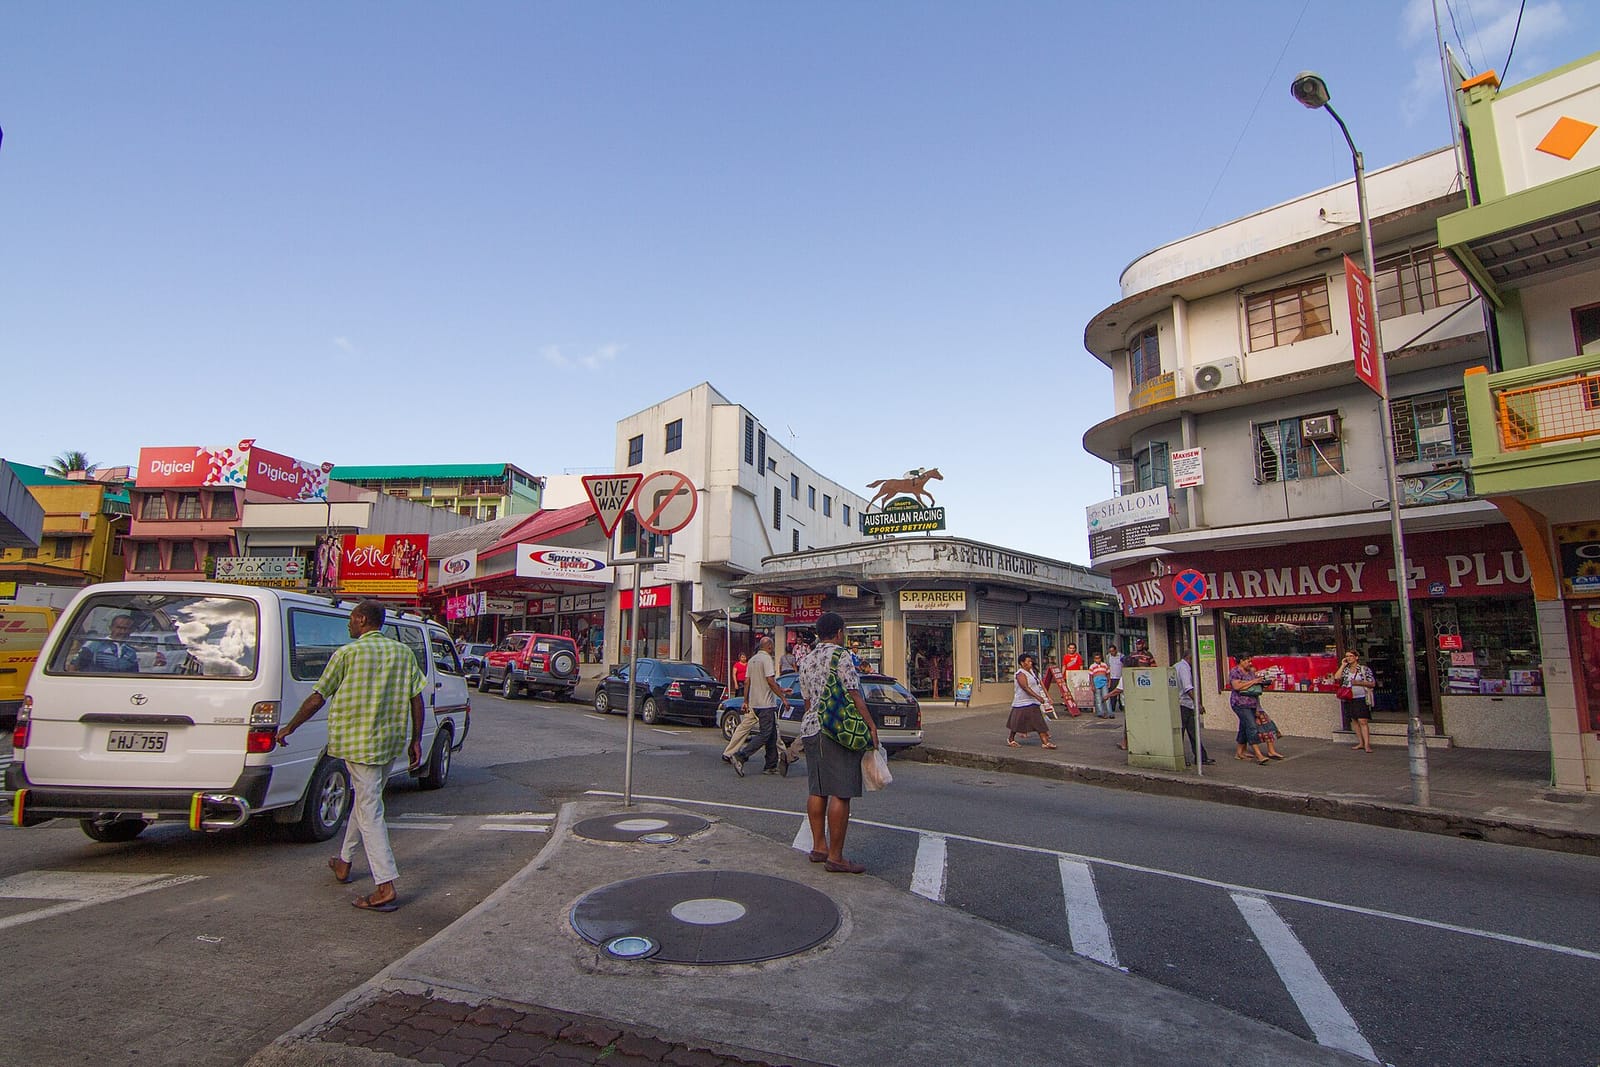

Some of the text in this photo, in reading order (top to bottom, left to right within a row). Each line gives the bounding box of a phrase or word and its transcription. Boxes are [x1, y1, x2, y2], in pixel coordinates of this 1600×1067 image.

[1352, 273, 1372, 377] Digicel
[151, 460, 194, 476] Digicel
[257, 462, 299, 484] Digicel
[594, 480, 628, 497] GIVE
[598, 497, 624, 511] WAY
[1102, 493, 1160, 518] SHALOM
[864, 509, 942, 526] AUSTRALIAN RACING
[868, 522, 938, 534] SPORTS BETTING
[548, 553, 582, 564] Sports
[933, 543, 994, 569] PAREKH
[1203, 562, 1365, 600] HARMACY
[1446, 550, 1532, 588] PLU
[903, 592, 964, 602] S.P. PAREKH
[1128, 579, 1164, 609] PLUS
[1231, 612, 1324, 624] RENWICK PHARMACY
